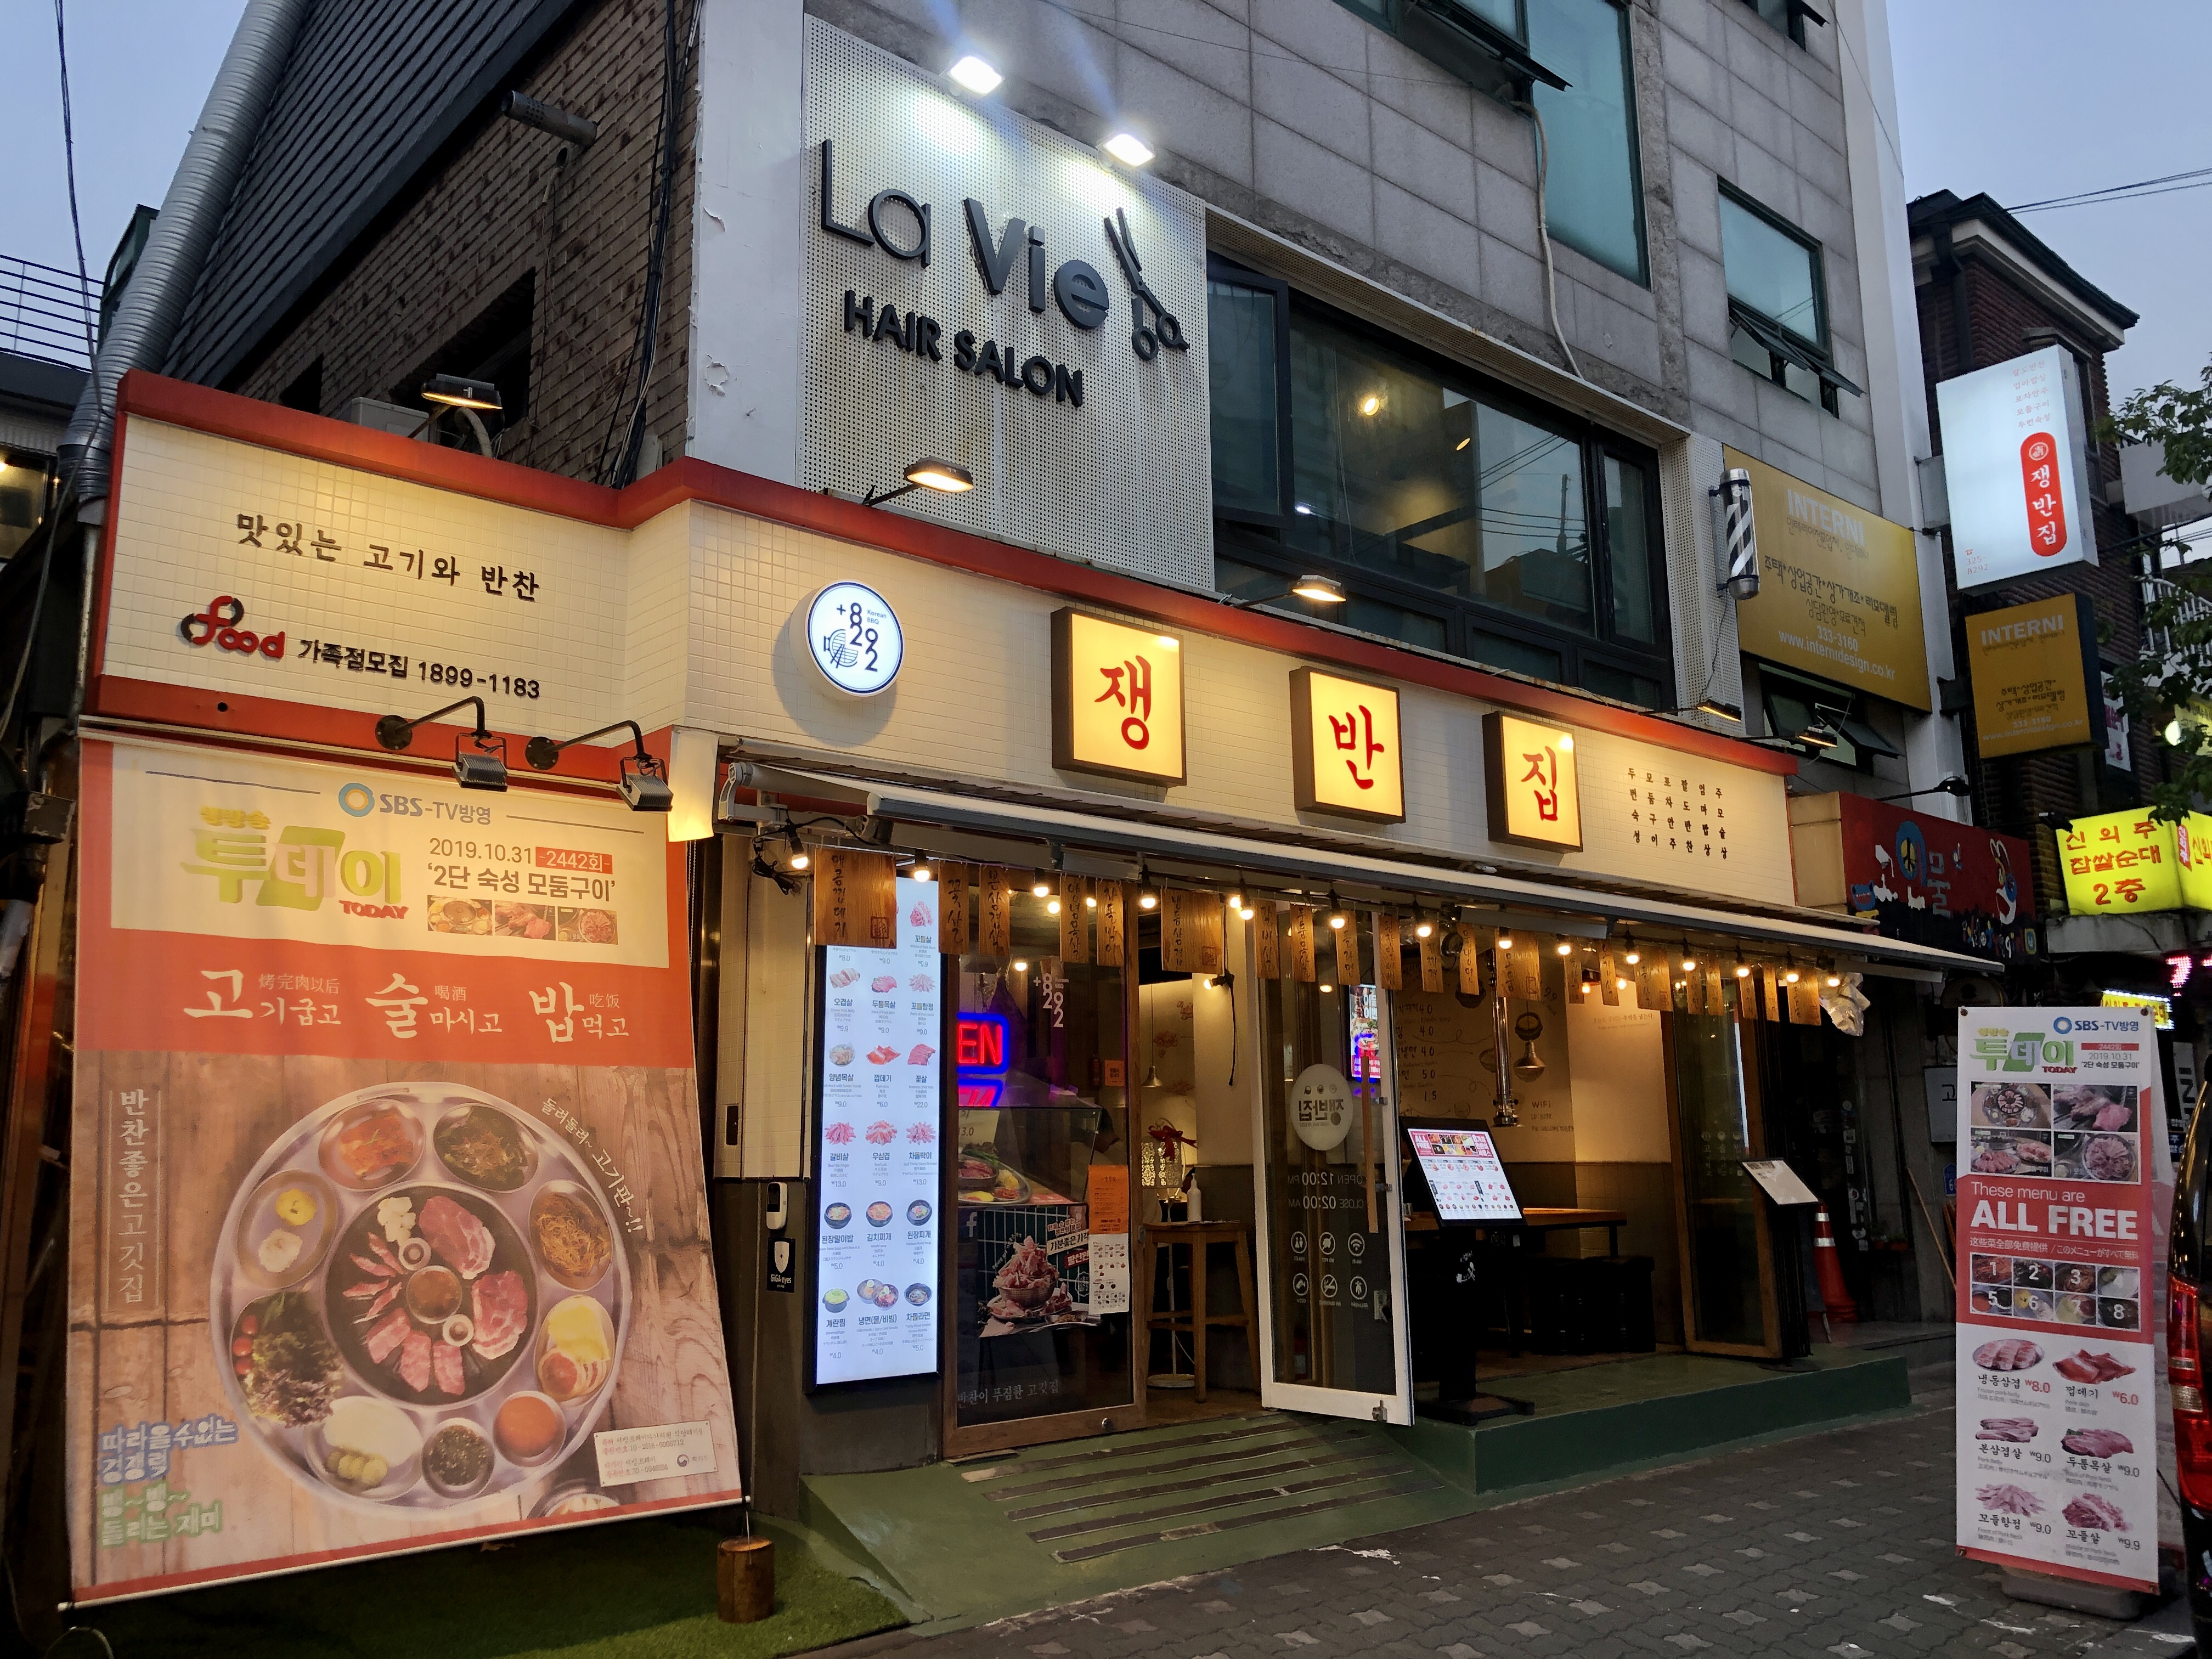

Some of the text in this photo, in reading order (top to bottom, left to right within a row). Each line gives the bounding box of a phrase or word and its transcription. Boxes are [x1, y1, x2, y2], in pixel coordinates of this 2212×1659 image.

[821, 139, 1109, 329] La Vie
[844, 290, 1083, 408] HAIR SALON
[2030, 464, 2057, 545] 쟁반집
[1787, 489, 1865, 546] INTERNI
[237, 513, 540, 602] 맛있는 고기와 반찬
[1967, 563, 1989, 575] 8292
[867, 610, 887, 619] Korean
[1981, 614, 2064, 646] INTERNI
[1816, 625, 1858, 653] 333-3160
[297, 639, 409, 680] 가족점모집
[418, 661, 540, 699] 1899-1183
[1094, 654, 1559, 822] 쟁 반 집
[379, 793, 492, 825] SBS-TV방영
[429, 837, 531, 864] 2019.10.31
[179, 827, 402, 905] 투데이
[2069, 844, 2162, 876] 찹쌀순대
[477, 868, 520, 893] 숙성
[338, 900, 409, 919] TODAY
[258, 973, 621, 1010] 烤完肉以后 喝酒 吃饭
[834, 998, 853, 1007] 오겹살
[2074, 1019, 2140, 1032] SBS-TV방영
[1970, 1038, 2074, 1071] 투데이
[2089, 1052, 2132, 1061] 2019.10.31
[829, 1073, 854, 1082] 양념목살
[873, 1074, 891, 1082] 껍데기
[830, 1152, 932, 1161] 갈비살 우삼겹 차돌박이
[1971, 1181, 2085, 1203] These menu are
[1970, 1200, 2138, 1240] ALL FREE
[822, 1231, 931, 1244] 된장말이밥 김치찌개 된장찌개
[1989, 1262, 1996, 1276] 1
[2029, 1265, 2039, 1280] 2
[2070, 1269, 2081, 1284] 3
[1988, 1291, 1997, 1306] 5
[2029, 1295, 2039, 1310] 6
[826, 1318, 845, 1328] 계란찜
[906, 1312, 930, 1321] 차돌라면
[2113, 1304, 2125, 1319] 8
[992, 1385, 1023, 1402] 푸짐한
[1028, 1379, 1058, 1396] 고깃집
[1978, 1374, 2021, 1390] 냉동삼겹
[2066, 1386, 2098, 1399] 껍데기
[1979, 1443, 2022, 1459] 본삼겹살
[1978, 1514, 2021, 1530] 꼬들항정
[2066, 1530, 2101, 1544] 꼬들살
